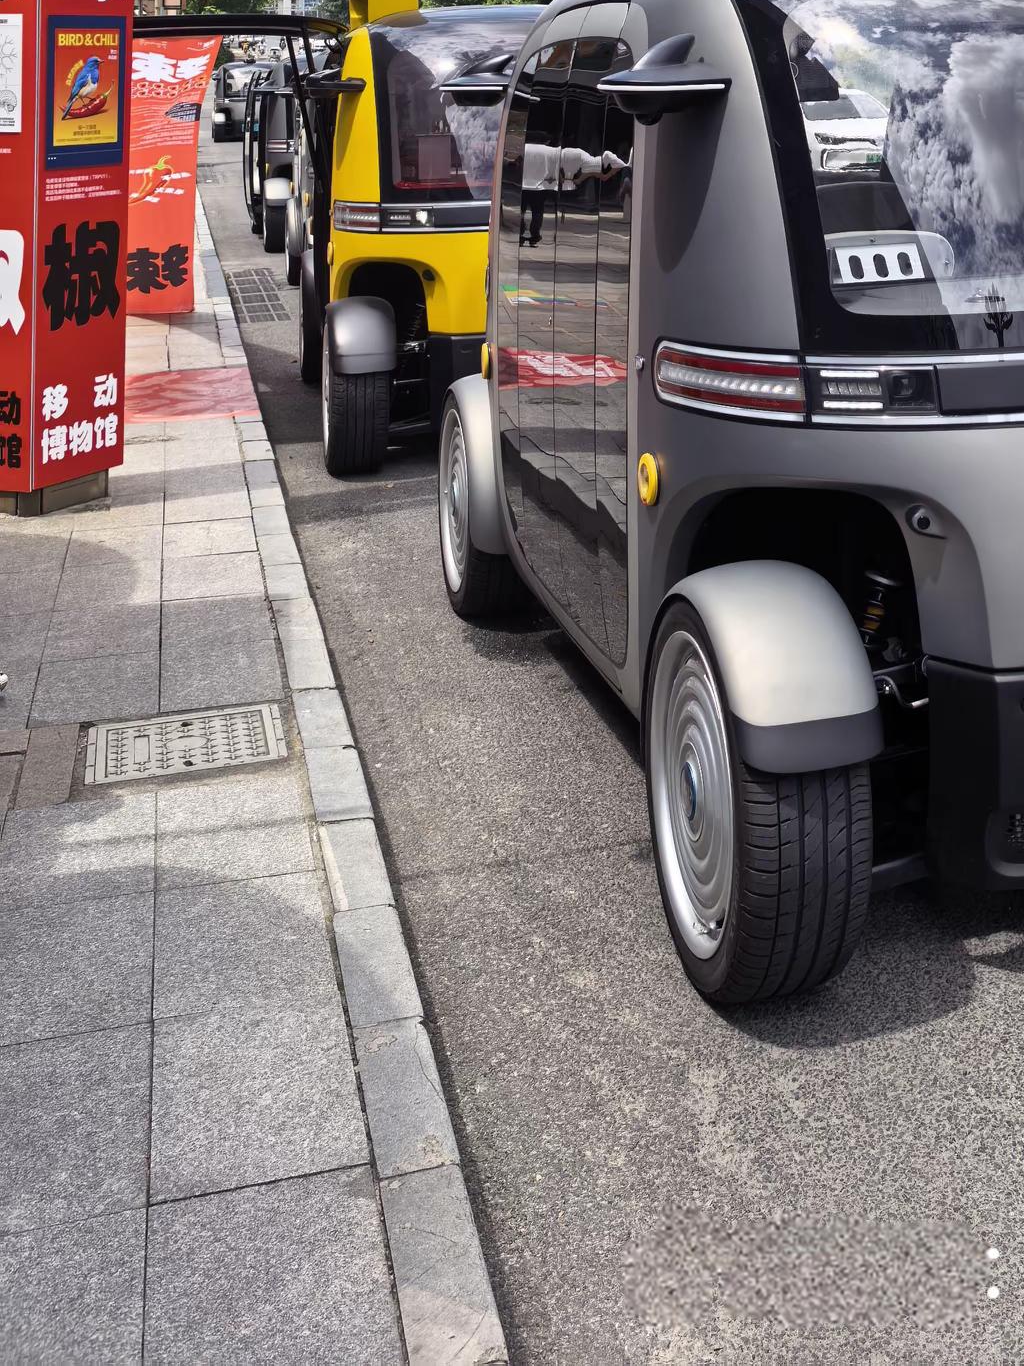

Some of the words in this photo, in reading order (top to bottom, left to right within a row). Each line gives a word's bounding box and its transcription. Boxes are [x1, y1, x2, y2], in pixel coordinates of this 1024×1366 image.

[42, 220, 121, 331] 椒
[41, 412, 119, 465] 博物馆
